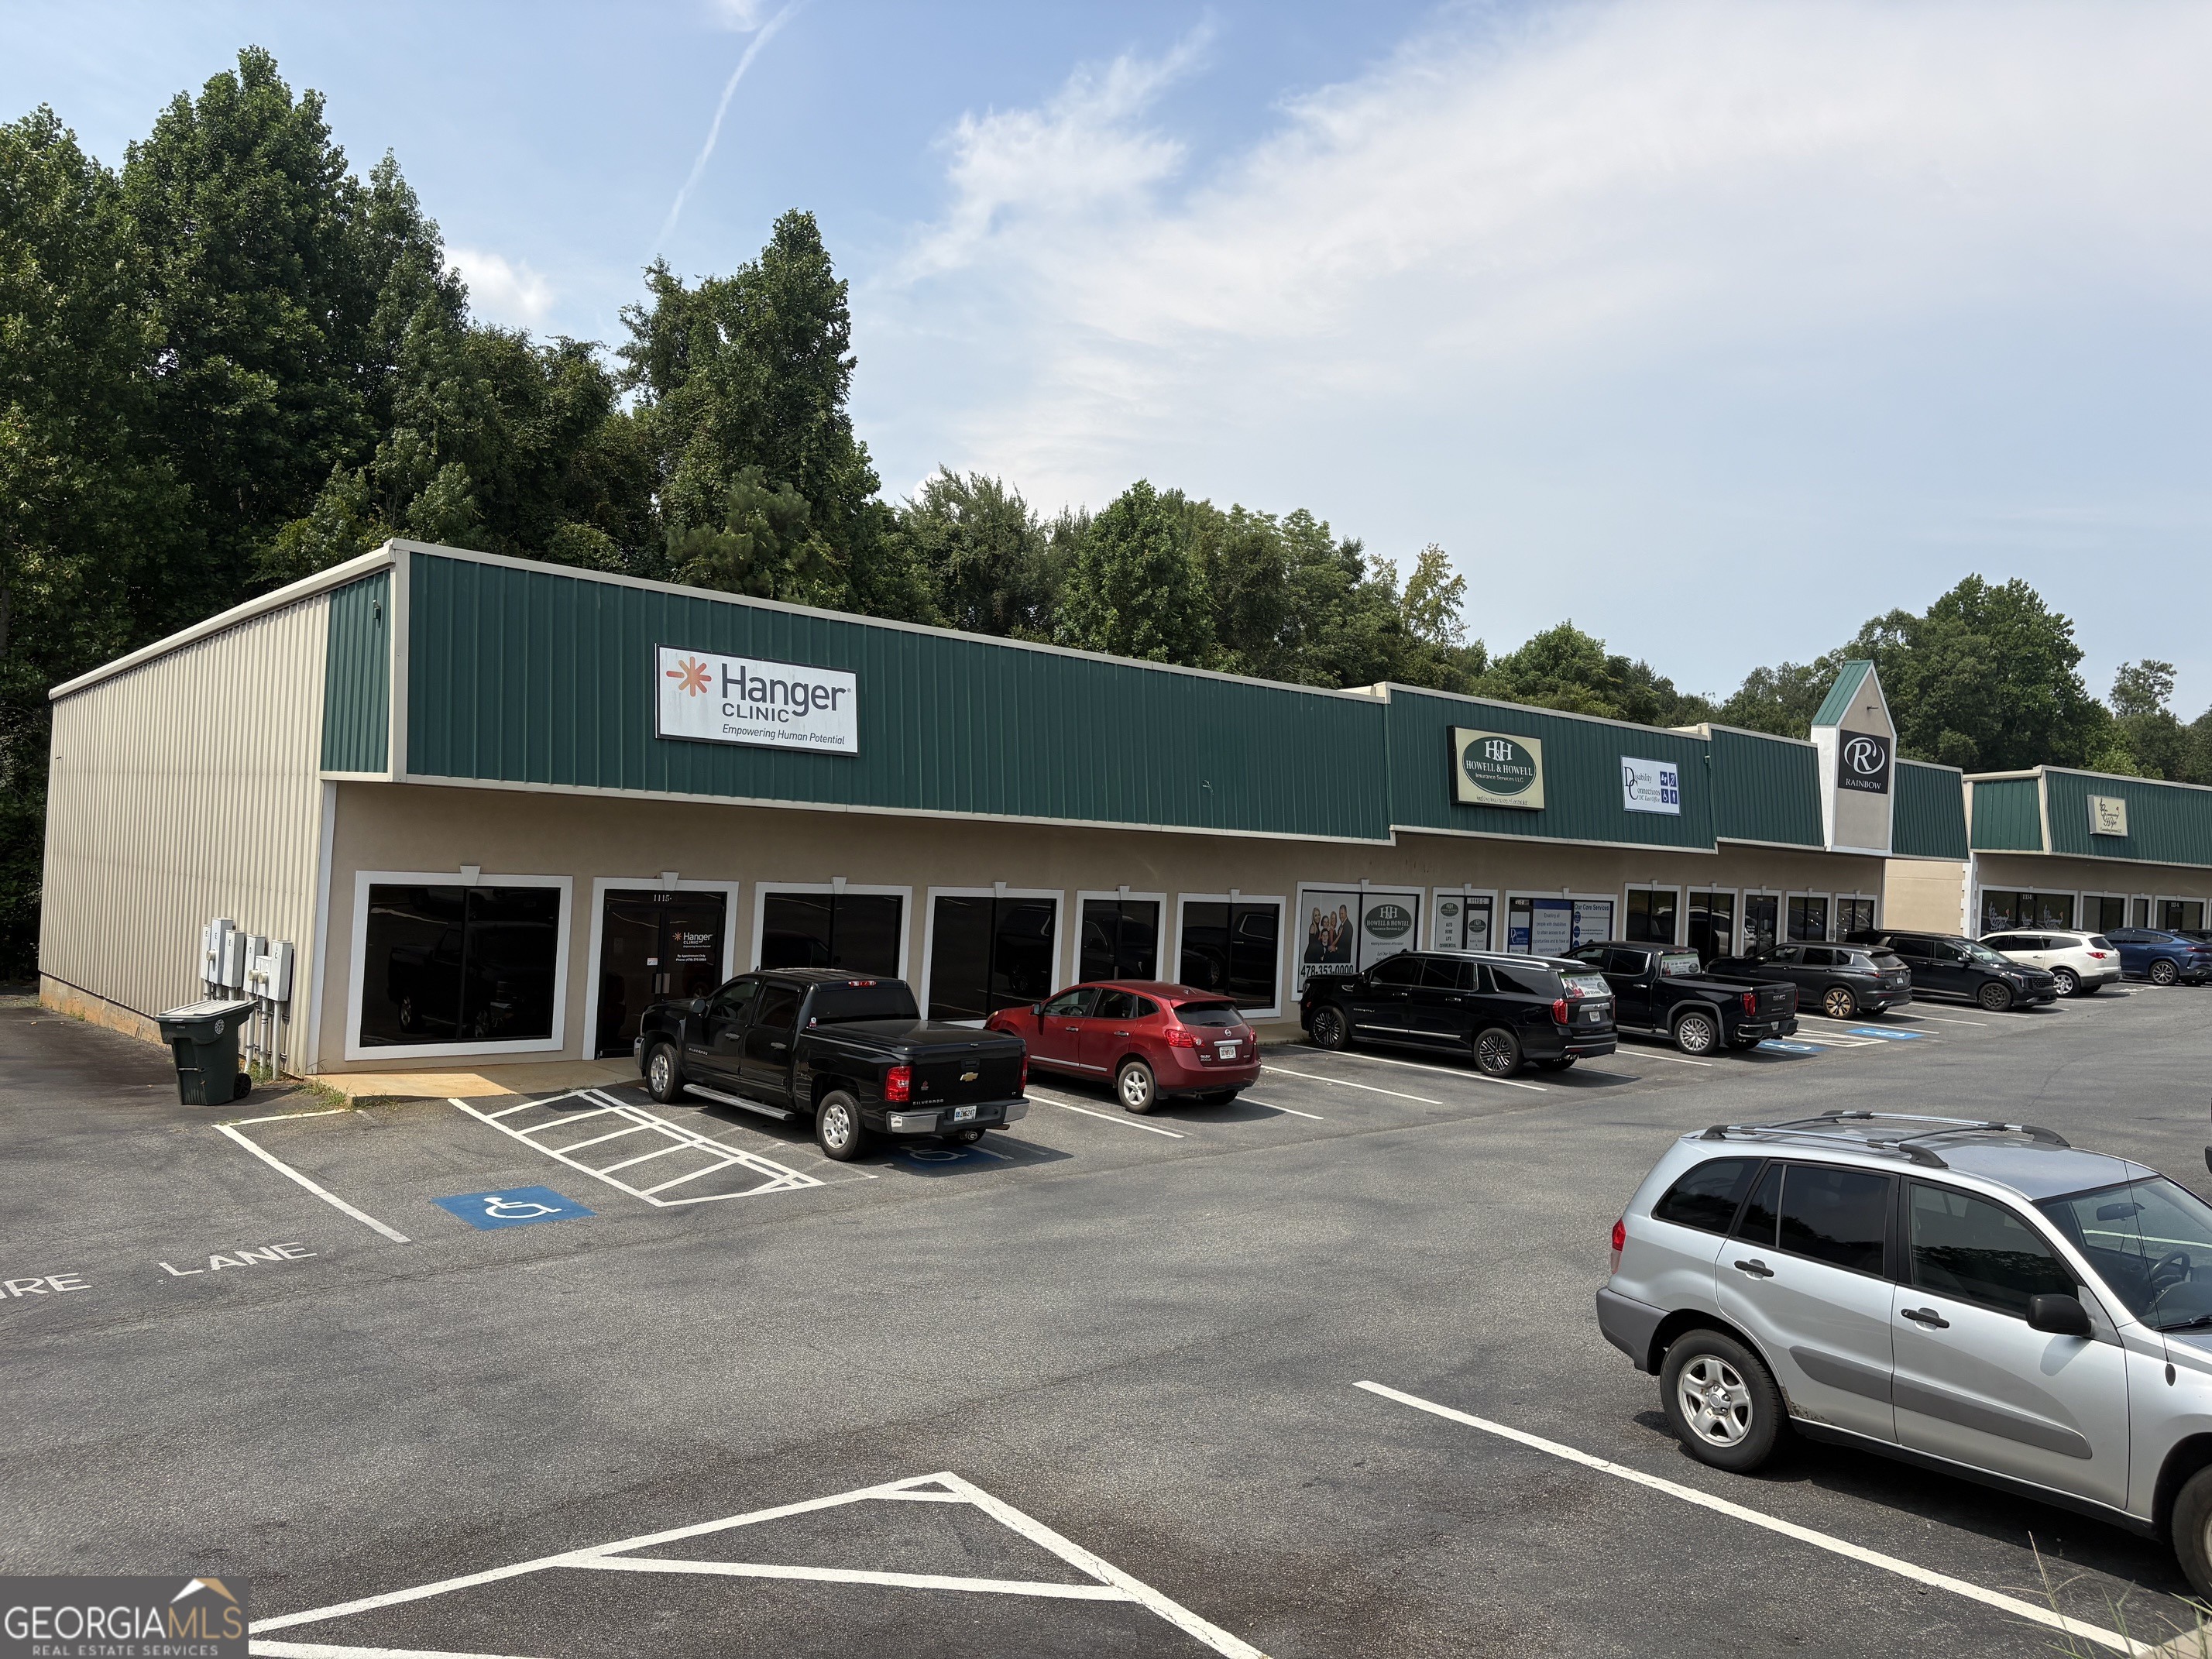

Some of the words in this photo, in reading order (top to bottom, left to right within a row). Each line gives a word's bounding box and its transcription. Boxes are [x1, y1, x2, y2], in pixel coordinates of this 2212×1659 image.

[722, 663, 847, 716] Hanger
[722, 702, 789, 723] CLINIC
[723, 724, 775, 740] Empowering
[778, 730, 807, 741] Human
[809, 733, 845, 745] Potential
[1466, 760, 1495, 772] HOWELL
[1496, 764, 1502, 773] &
[1503, 764, 1533, 777] HOWELL
[1475, 772, 1496, 781] Insurance
[1846, 778, 1881, 789] RAINBOW
[683, 932, 712, 943] Hanger
[158, 1242, 318, 1276] LANE
